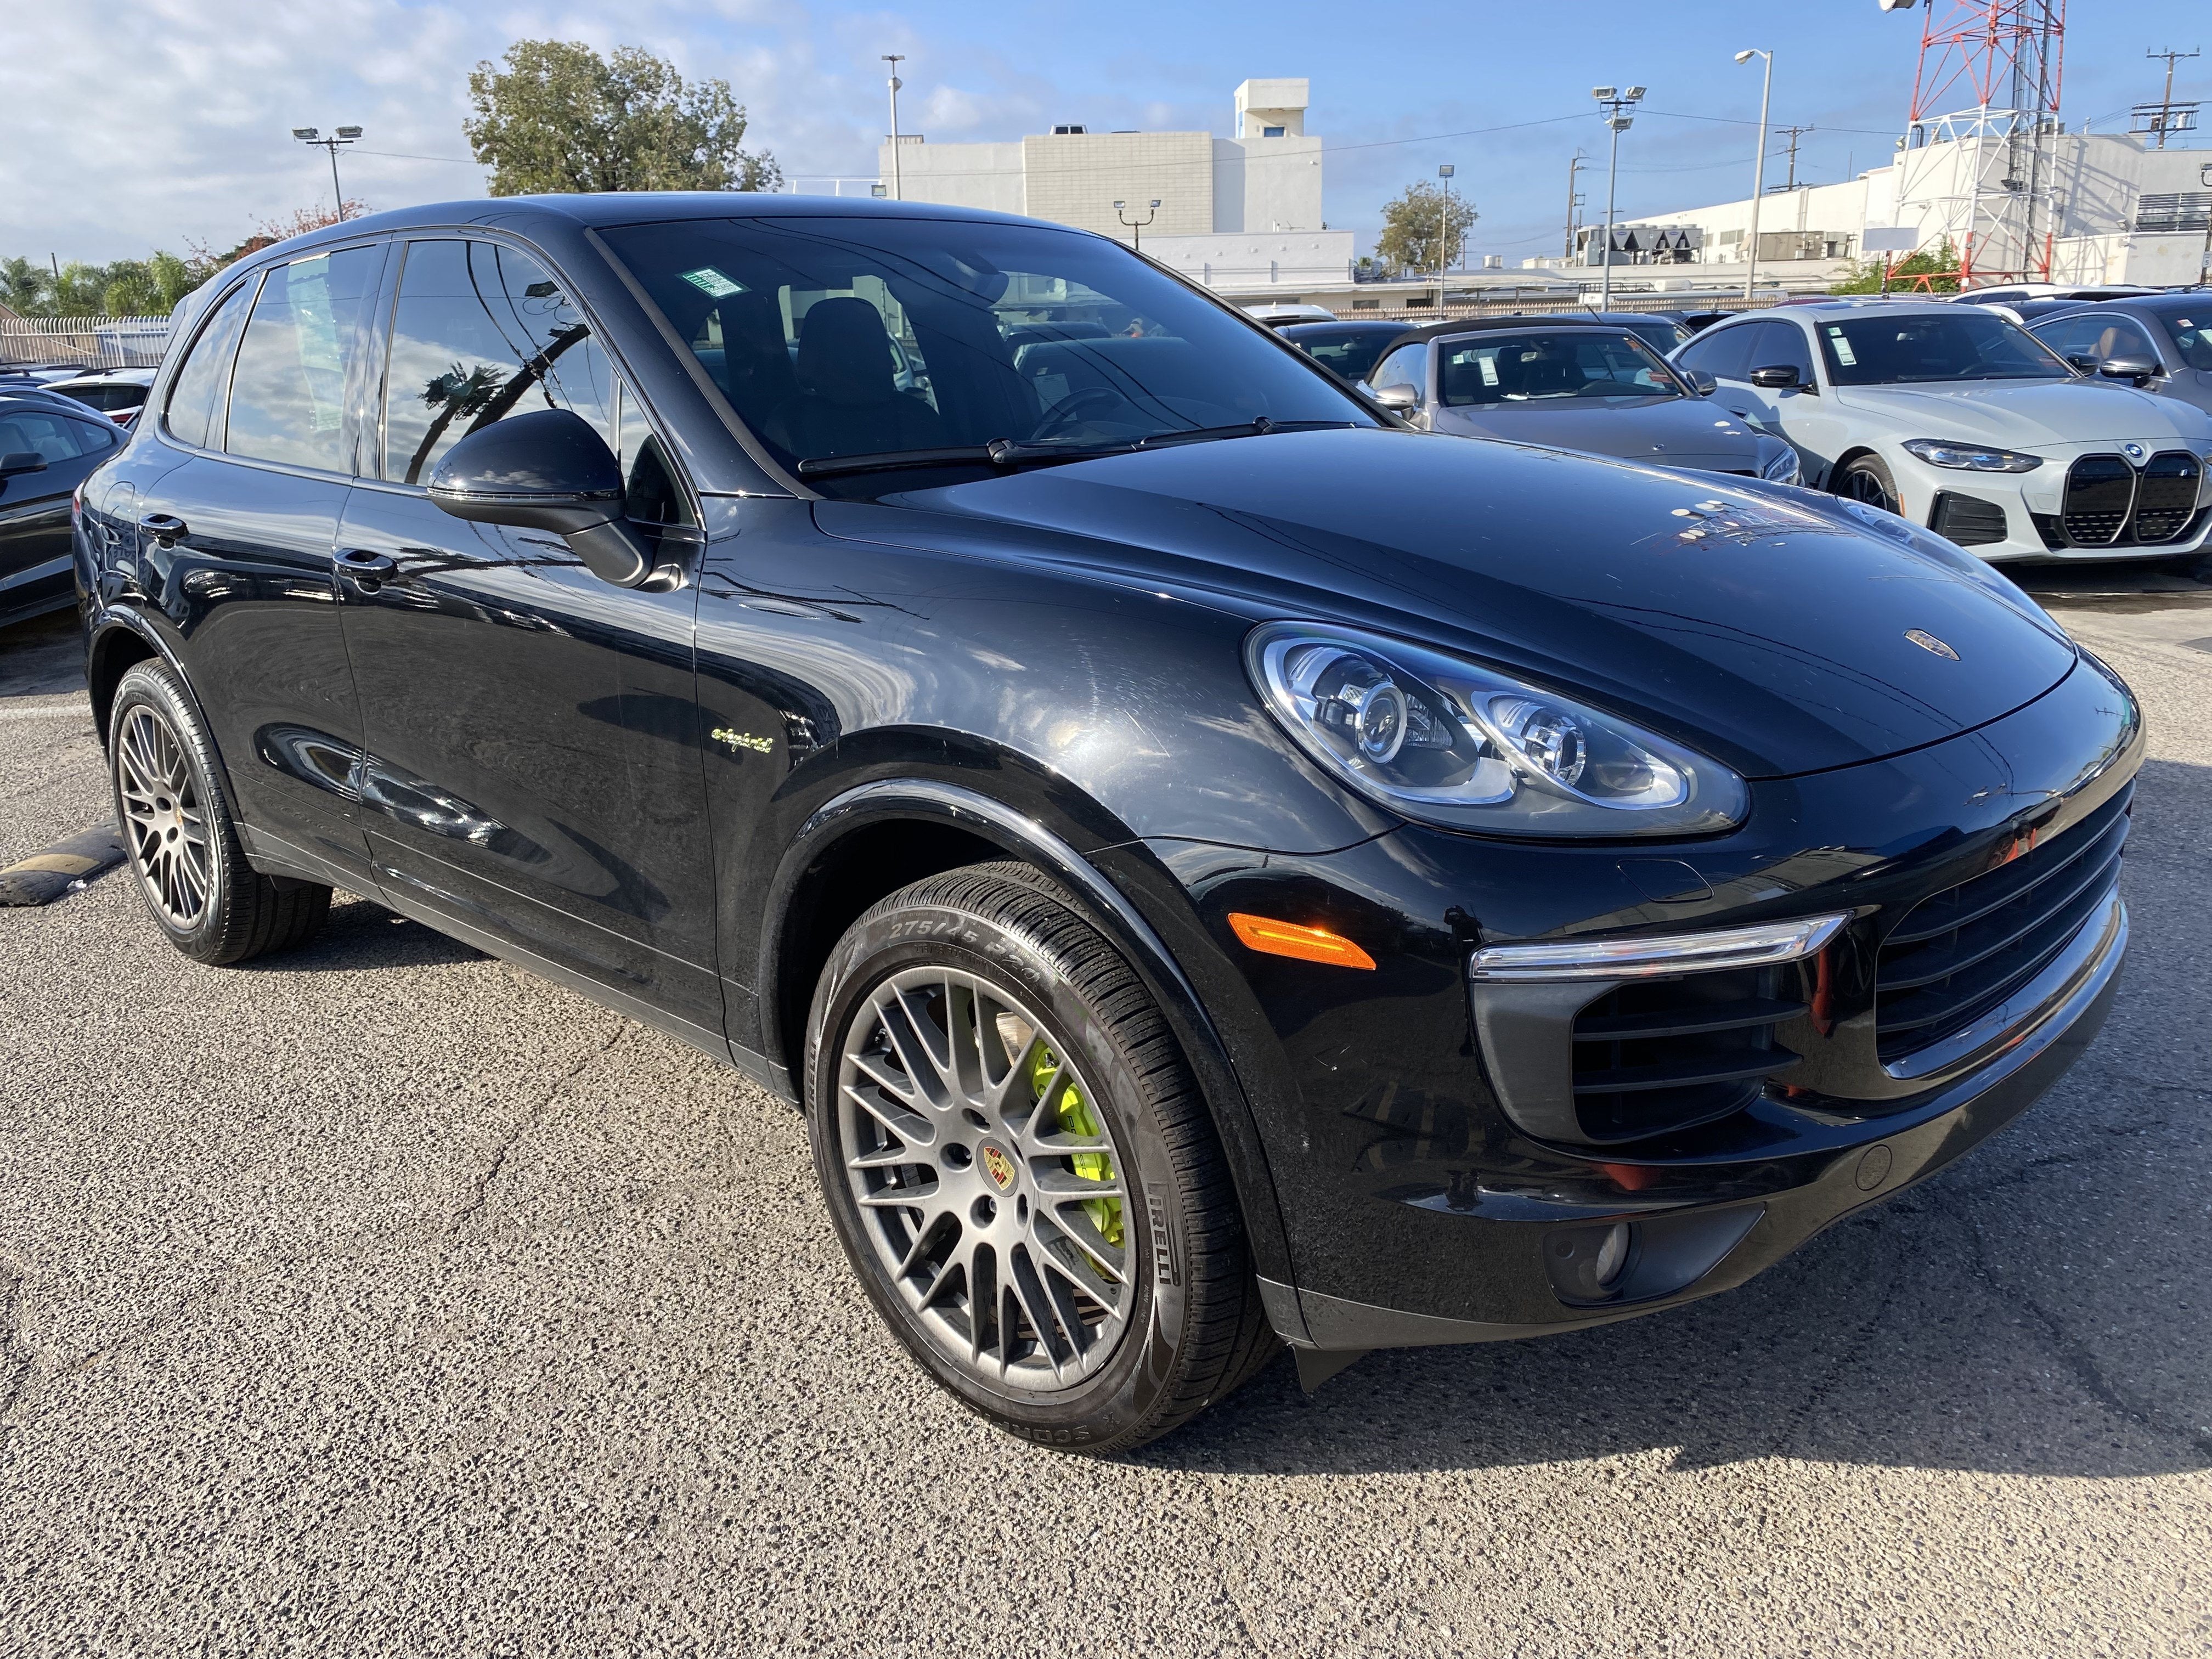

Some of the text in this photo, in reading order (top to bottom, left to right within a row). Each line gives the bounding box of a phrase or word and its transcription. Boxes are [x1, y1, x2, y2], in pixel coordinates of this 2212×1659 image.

[888, 920, 980, 943] 275/45
[984, 941, 1042, 983] R20
[806, 1037, 816, 1122] PIRELLI
[1147, 1183, 1181, 1286] PIRELLI
